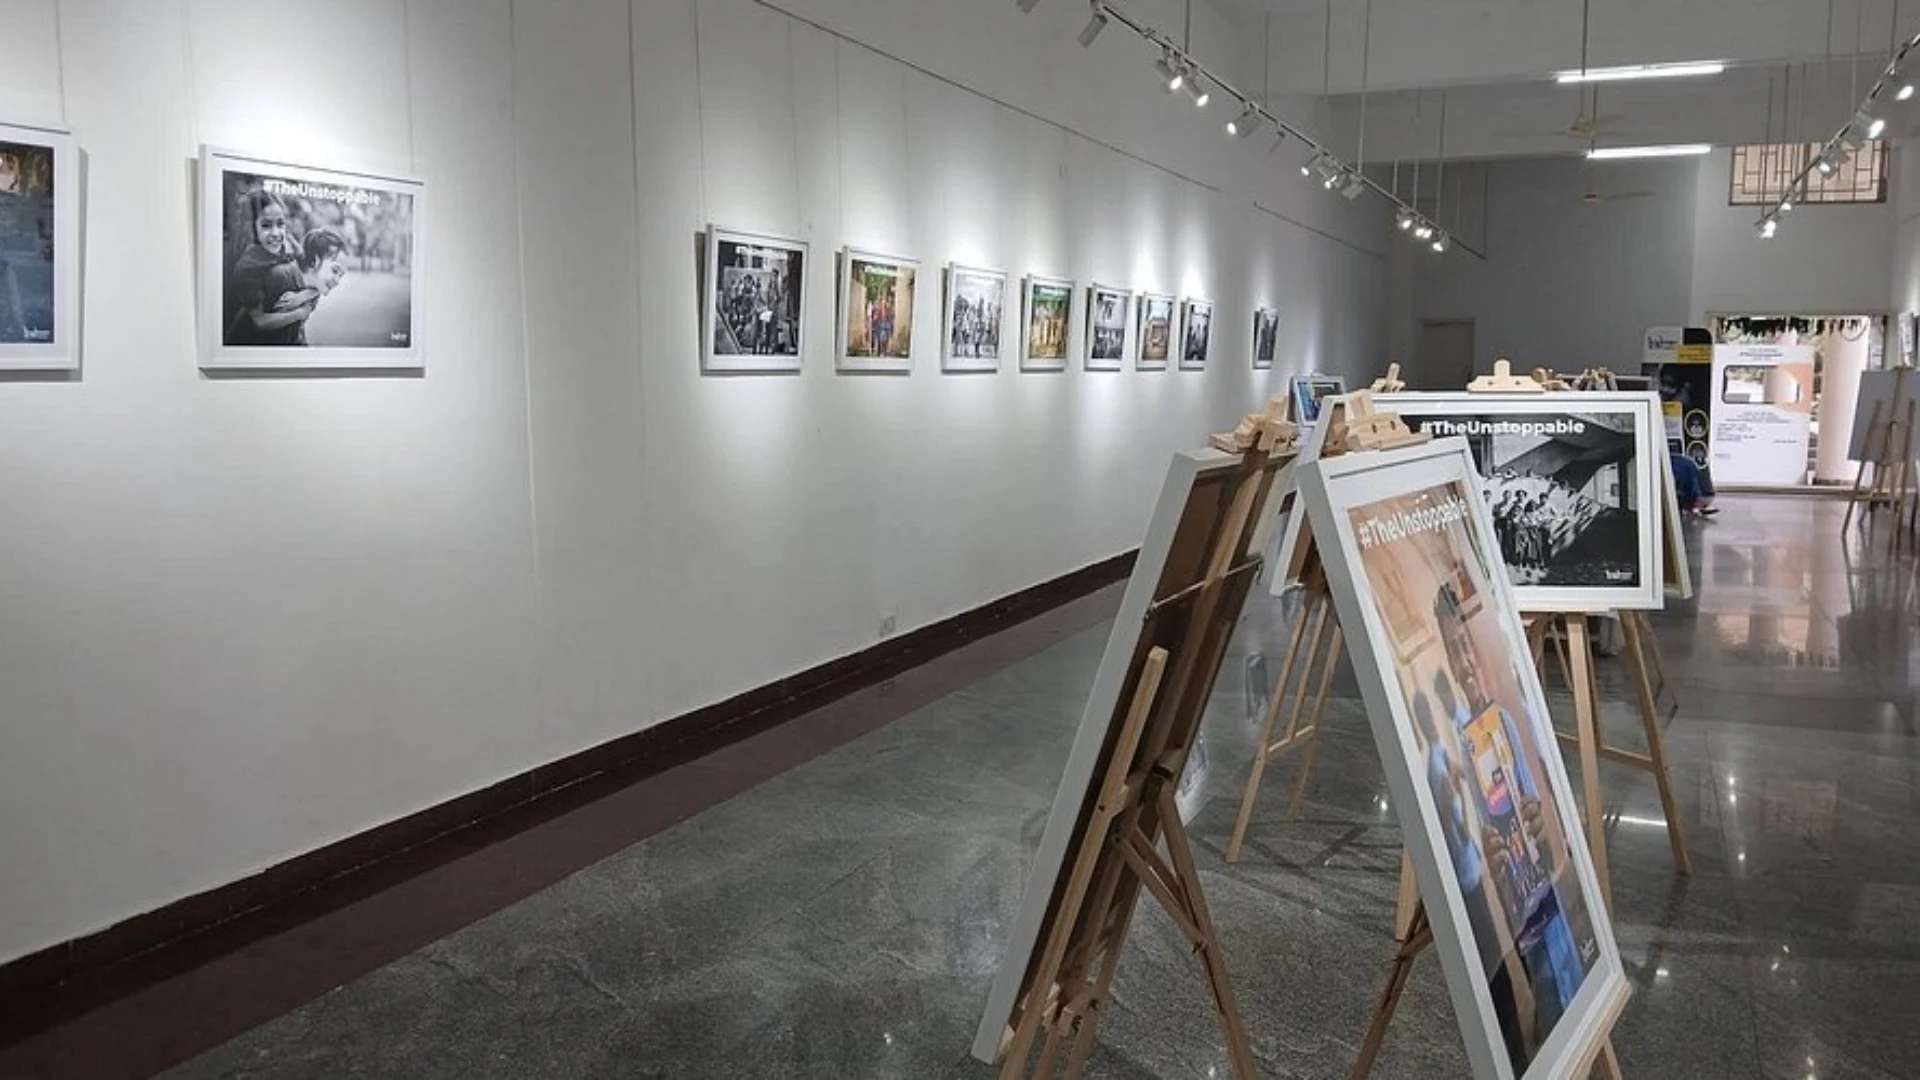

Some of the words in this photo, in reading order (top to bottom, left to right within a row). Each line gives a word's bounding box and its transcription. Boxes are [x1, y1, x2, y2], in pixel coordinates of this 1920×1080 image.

[263, 179, 381, 206] #TheUnstoppable
[1420, 419, 1585, 437] #TheUnstoppable
[1359, 494, 1467, 549] #TheUnstoppable
